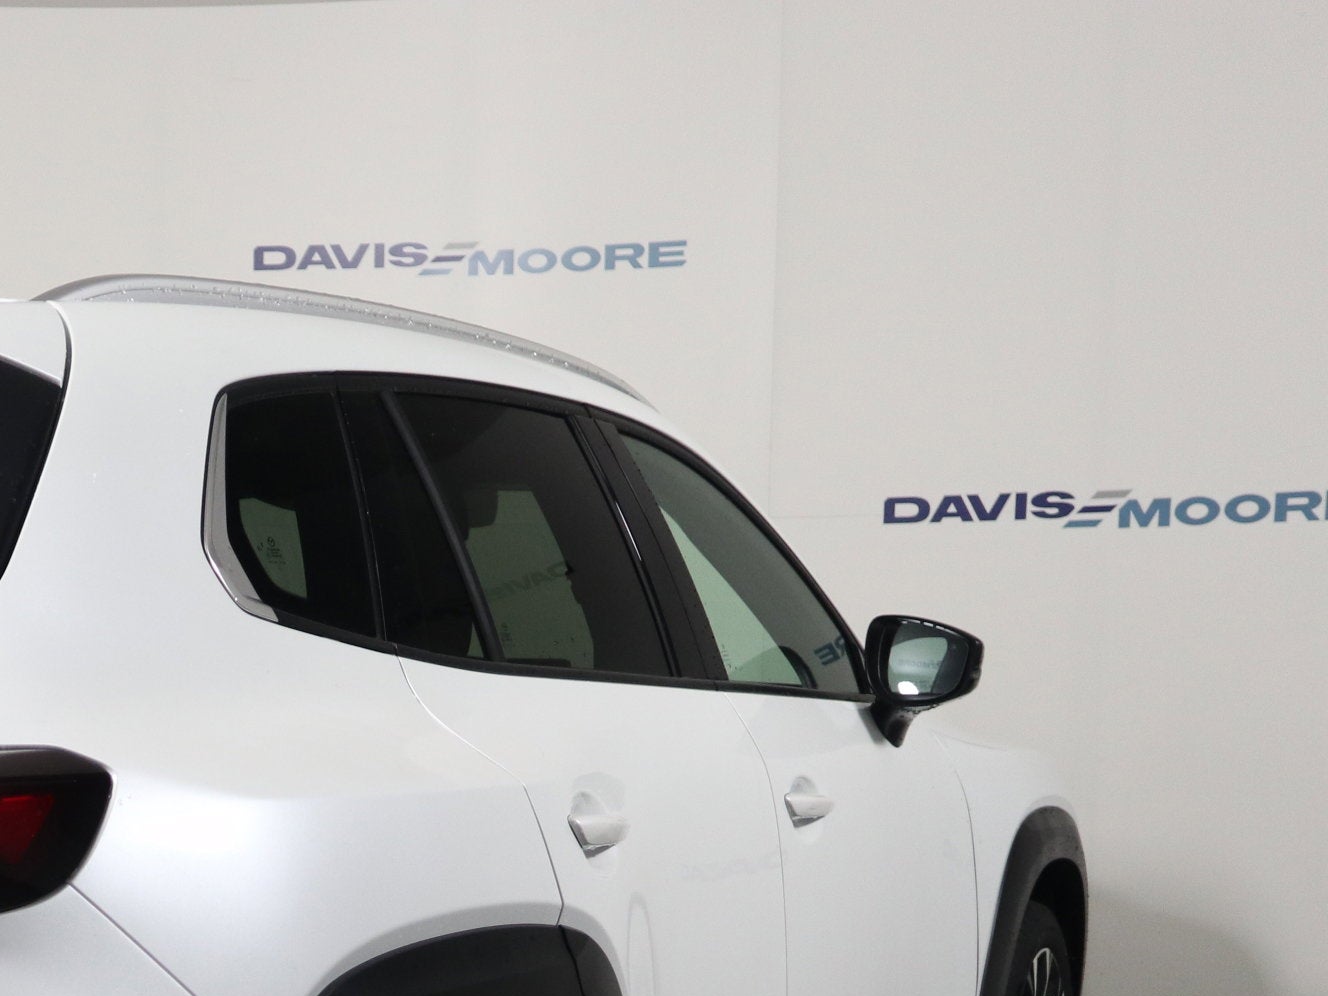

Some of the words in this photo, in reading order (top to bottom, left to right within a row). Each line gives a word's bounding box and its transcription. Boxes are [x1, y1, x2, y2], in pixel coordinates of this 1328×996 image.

[253, 242, 428, 271] DAVIS
[469, 241, 688, 276] MOORE
[883, 491, 1076, 525] DAVIS
[1118, 490, 1328, 529] MOOR
